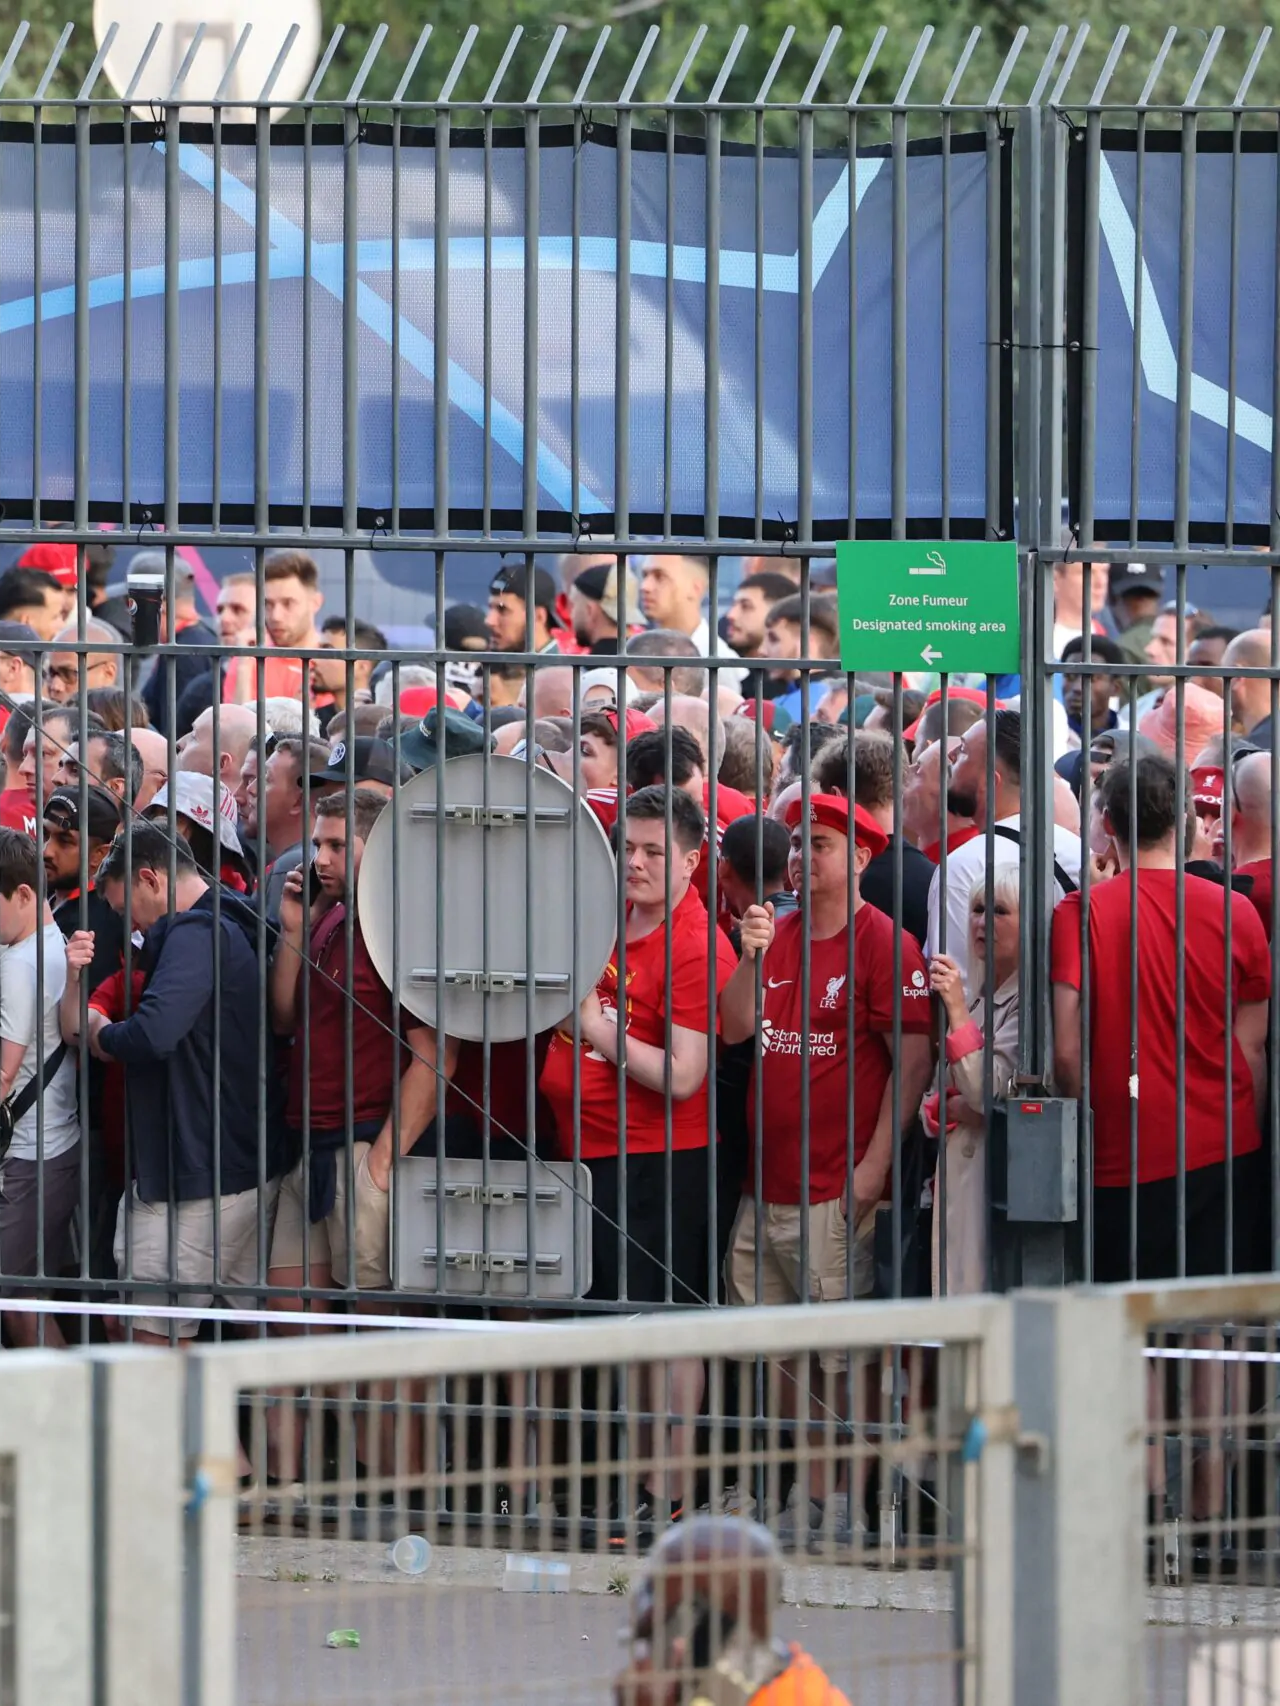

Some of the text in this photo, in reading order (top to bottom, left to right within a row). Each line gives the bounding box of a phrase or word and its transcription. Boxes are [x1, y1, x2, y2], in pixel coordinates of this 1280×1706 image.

[889, 594, 969, 606] Zone Fumeur
[853, 619, 1007, 634] Designated smoking area
[773, 1029, 834, 1044] stanard
